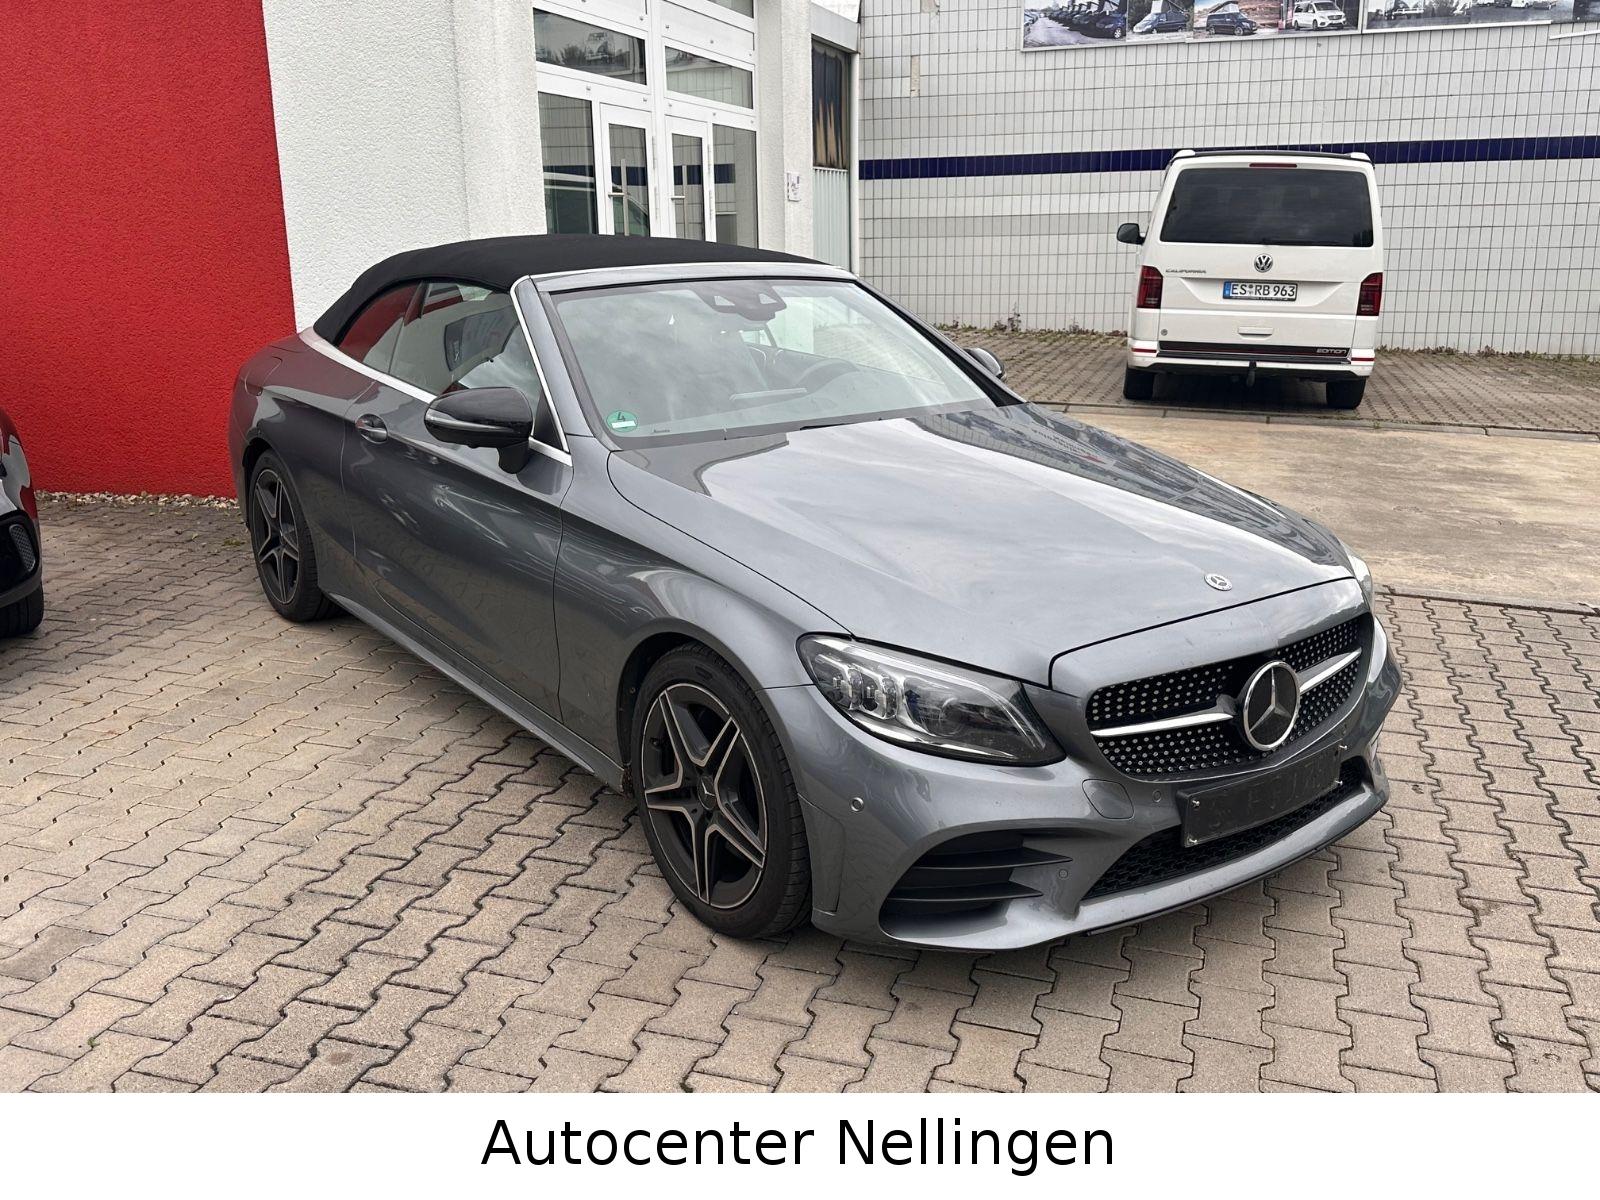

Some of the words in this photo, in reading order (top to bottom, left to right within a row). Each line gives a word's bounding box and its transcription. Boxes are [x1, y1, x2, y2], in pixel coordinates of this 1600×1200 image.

[1231, 283, 1247, 295] ES
[1254, 284, 1270, 296] RB
[1273, 285, 1295, 297] 963
[617, 411, 625, 421] 4
